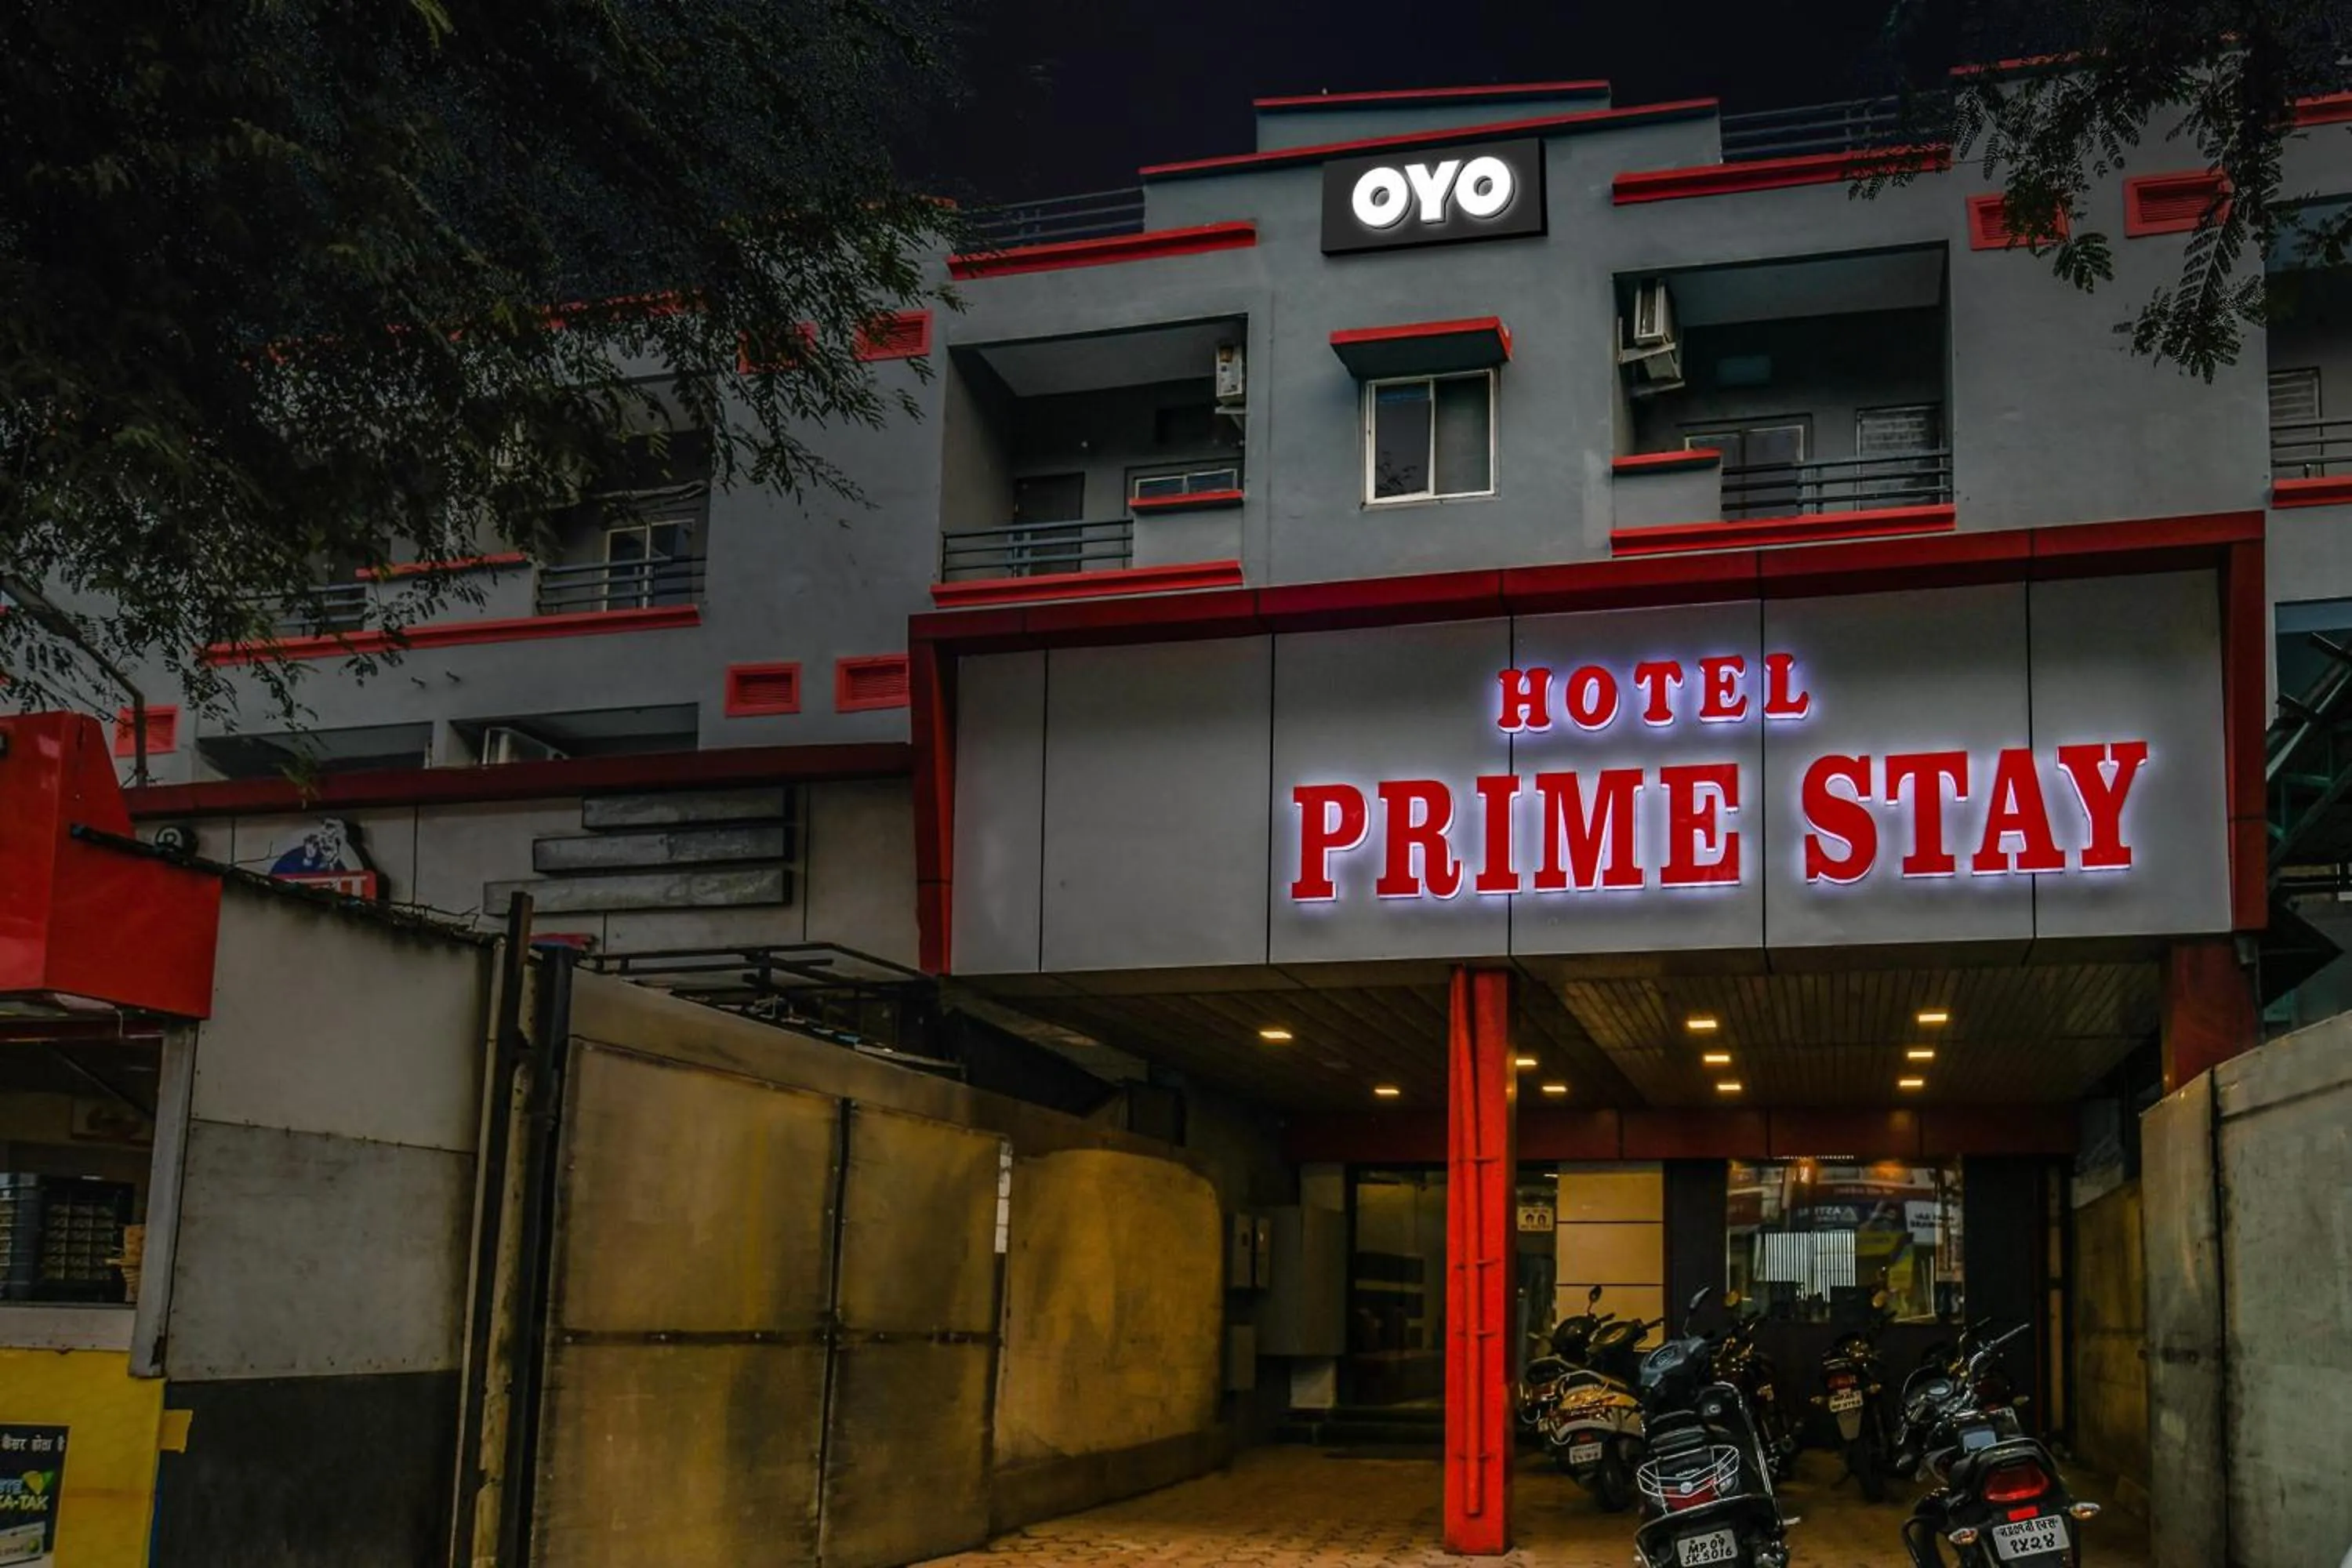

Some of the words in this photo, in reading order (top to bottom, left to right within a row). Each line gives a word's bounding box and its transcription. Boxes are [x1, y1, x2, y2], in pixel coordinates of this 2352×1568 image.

[1352, 156, 1514, 228] OYO
[1497, 652, 1809, 733] HOTEL
[1291, 763, 1741, 902] PRIME
[1802, 741, 2148, 884] STAY
